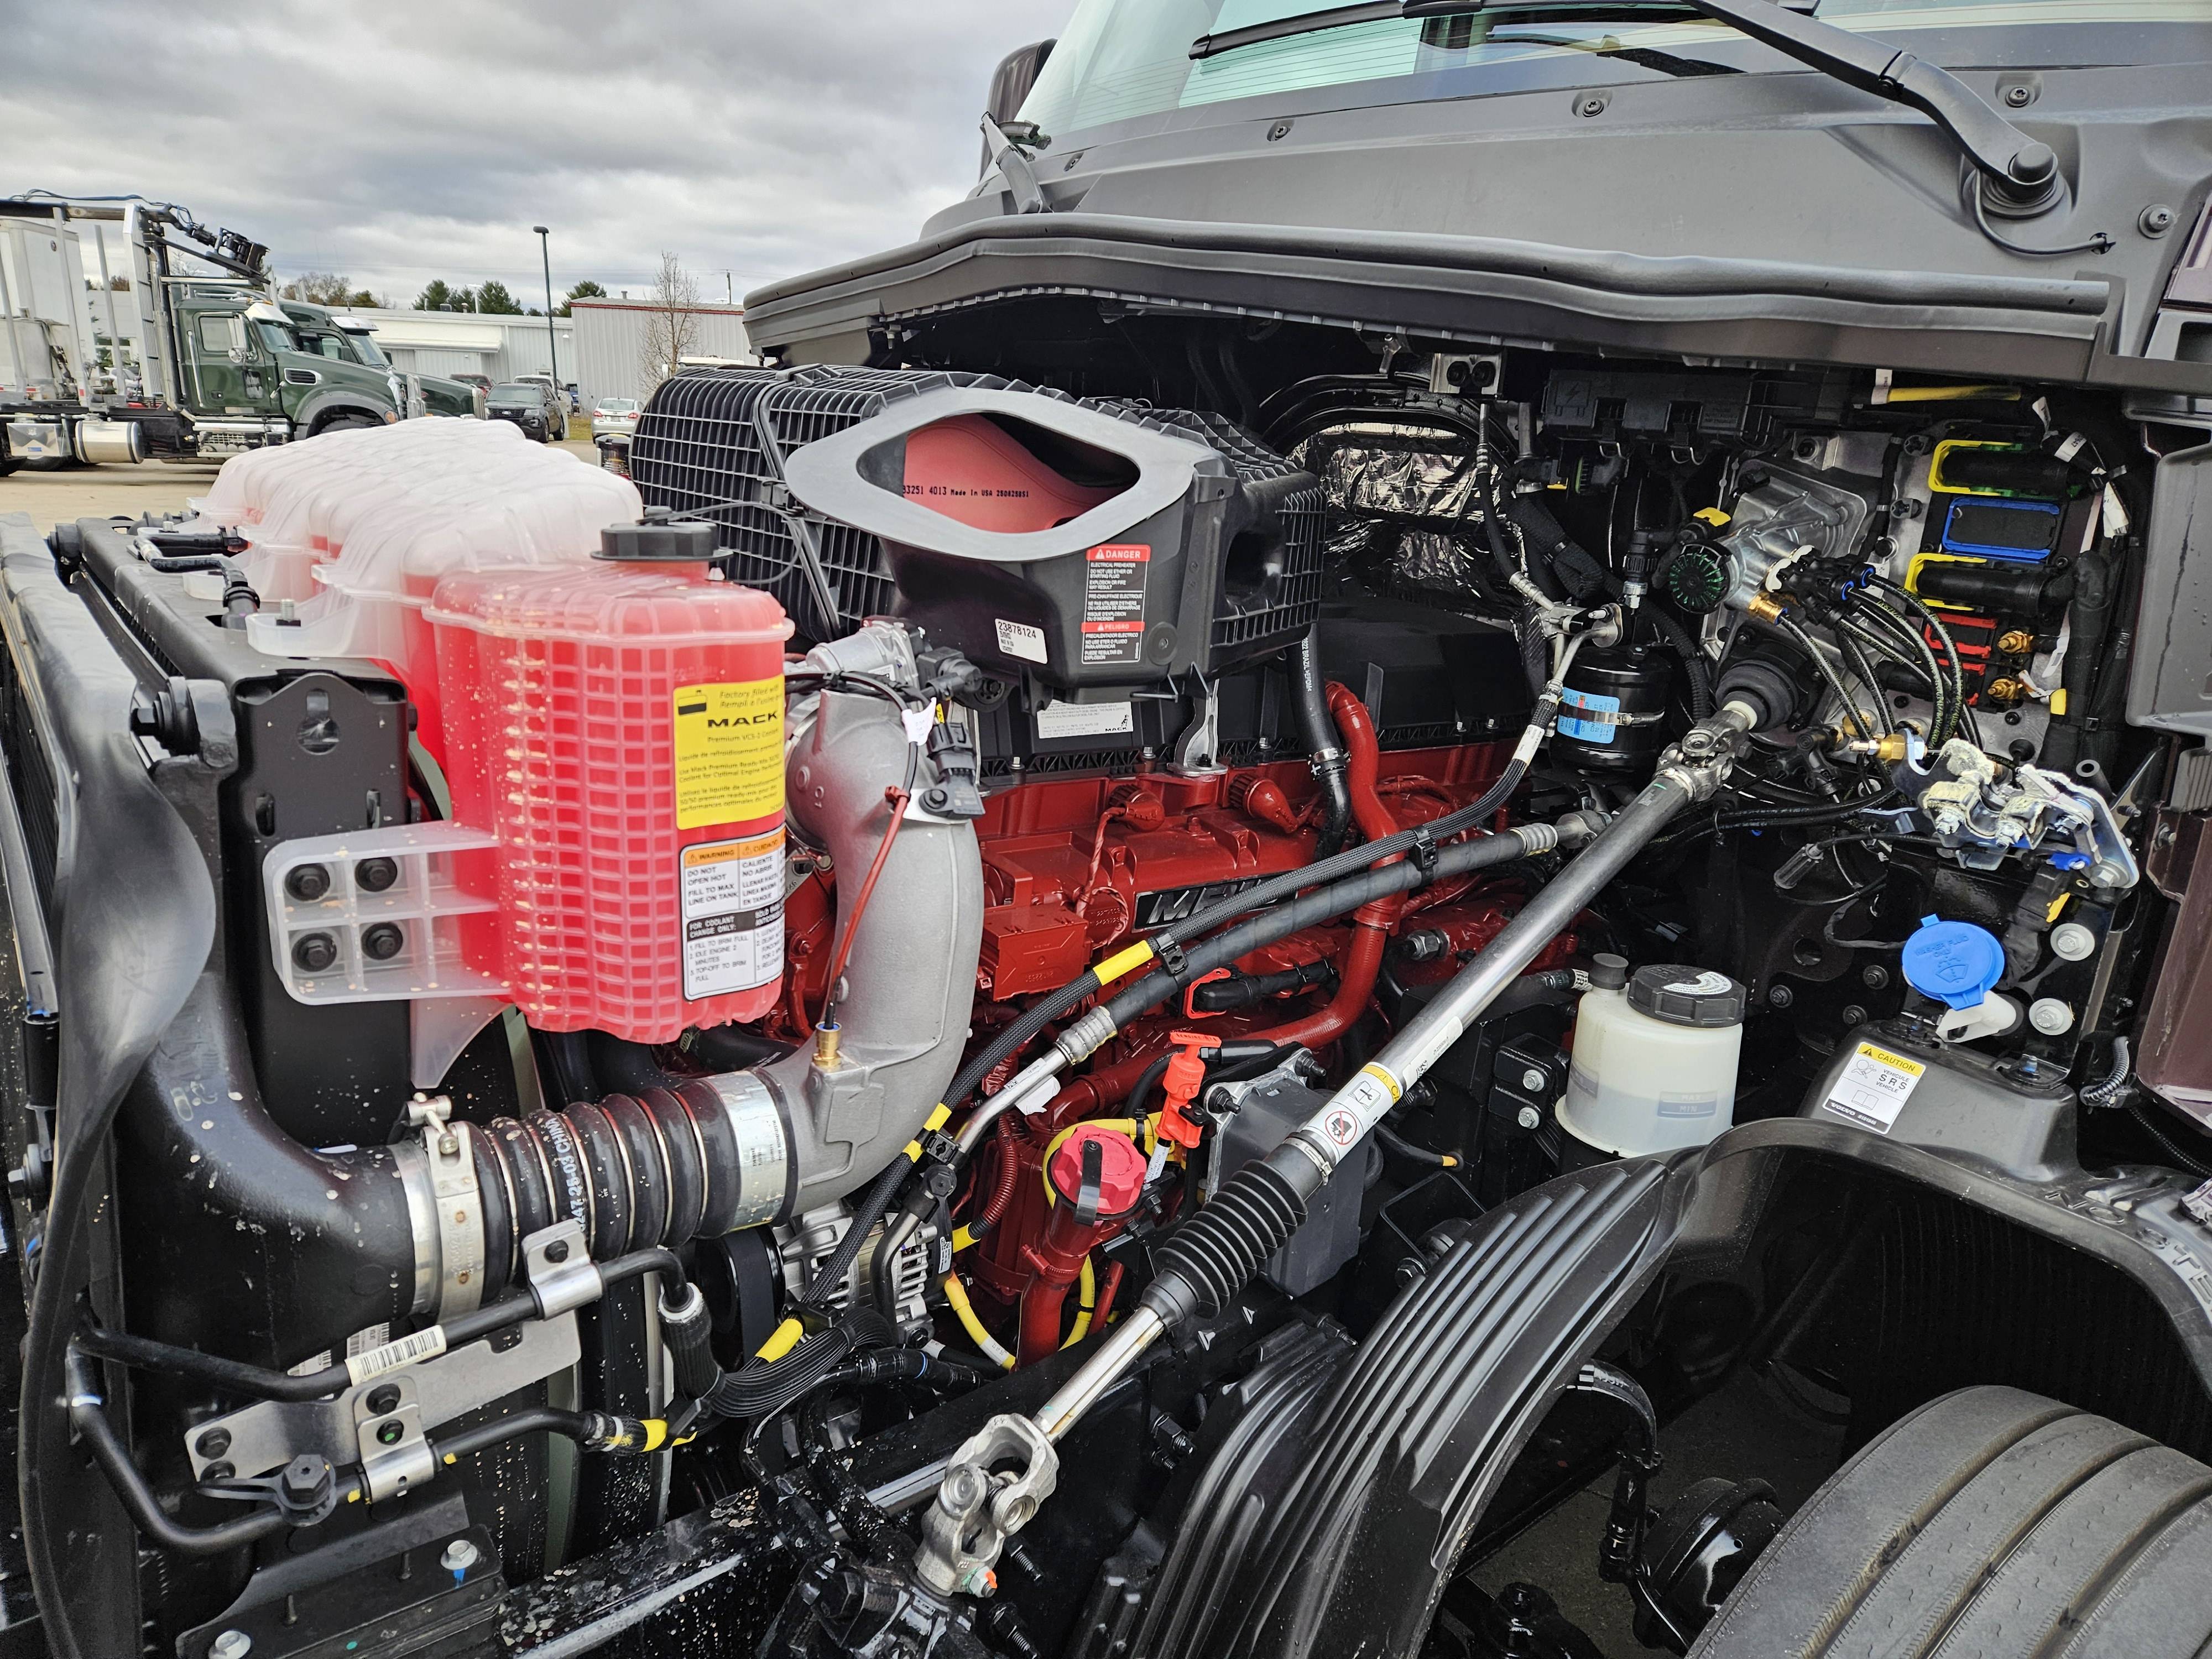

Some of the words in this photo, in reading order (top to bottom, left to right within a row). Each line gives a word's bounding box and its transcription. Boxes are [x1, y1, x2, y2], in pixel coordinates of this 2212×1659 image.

[929, 486, 947, 495] 4013
[1106, 550, 1141, 559] DANGER
[998, 621, 1036, 639] 23878124
[1302, 650, 1310, 670] BRAZIL
[719, 691, 750, 699] Factory
[708, 711, 778, 728] MACK
[707, 734, 740, 743] Premium
[679, 753, 699, 762] Liquide
[713, 769, 739, 778] Optimal
[699, 849, 735, 859] WARNING
[687, 869, 699, 878] DO
[688, 877, 709, 886] OPEN
[710, 874, 727, 882] HOT
[688, 889, 705, 898] FILL
[688, 897, 705, 906] LINE
[689, 922, 703, 931] FOR
[705, 916, 735, 926] COOLANT
[689, 928, 716, 938] CHANGE
[717, 924, 737, 933] ONLY:
[709, 946, 732, 955] ENGINE
[1915, 943, 1946, 956] WASHER
[1948, 935, 1969, 946] FLUID
[695, 957, 719, 966] MINUTES
[1877, 1053, 1916, 1072] CAUTION
[1883, 1068, 1910, 1083] VEHICULE
[1876, 1082, 1900, 1094] VEHICLE
[1830, 1102, 1856, 1116] VOLVO
[545, 1118, 571, 1154] CHINA
[560, 1155, 583, 1197] 25-03
[2045, 1190, 2125, 1225] NO
